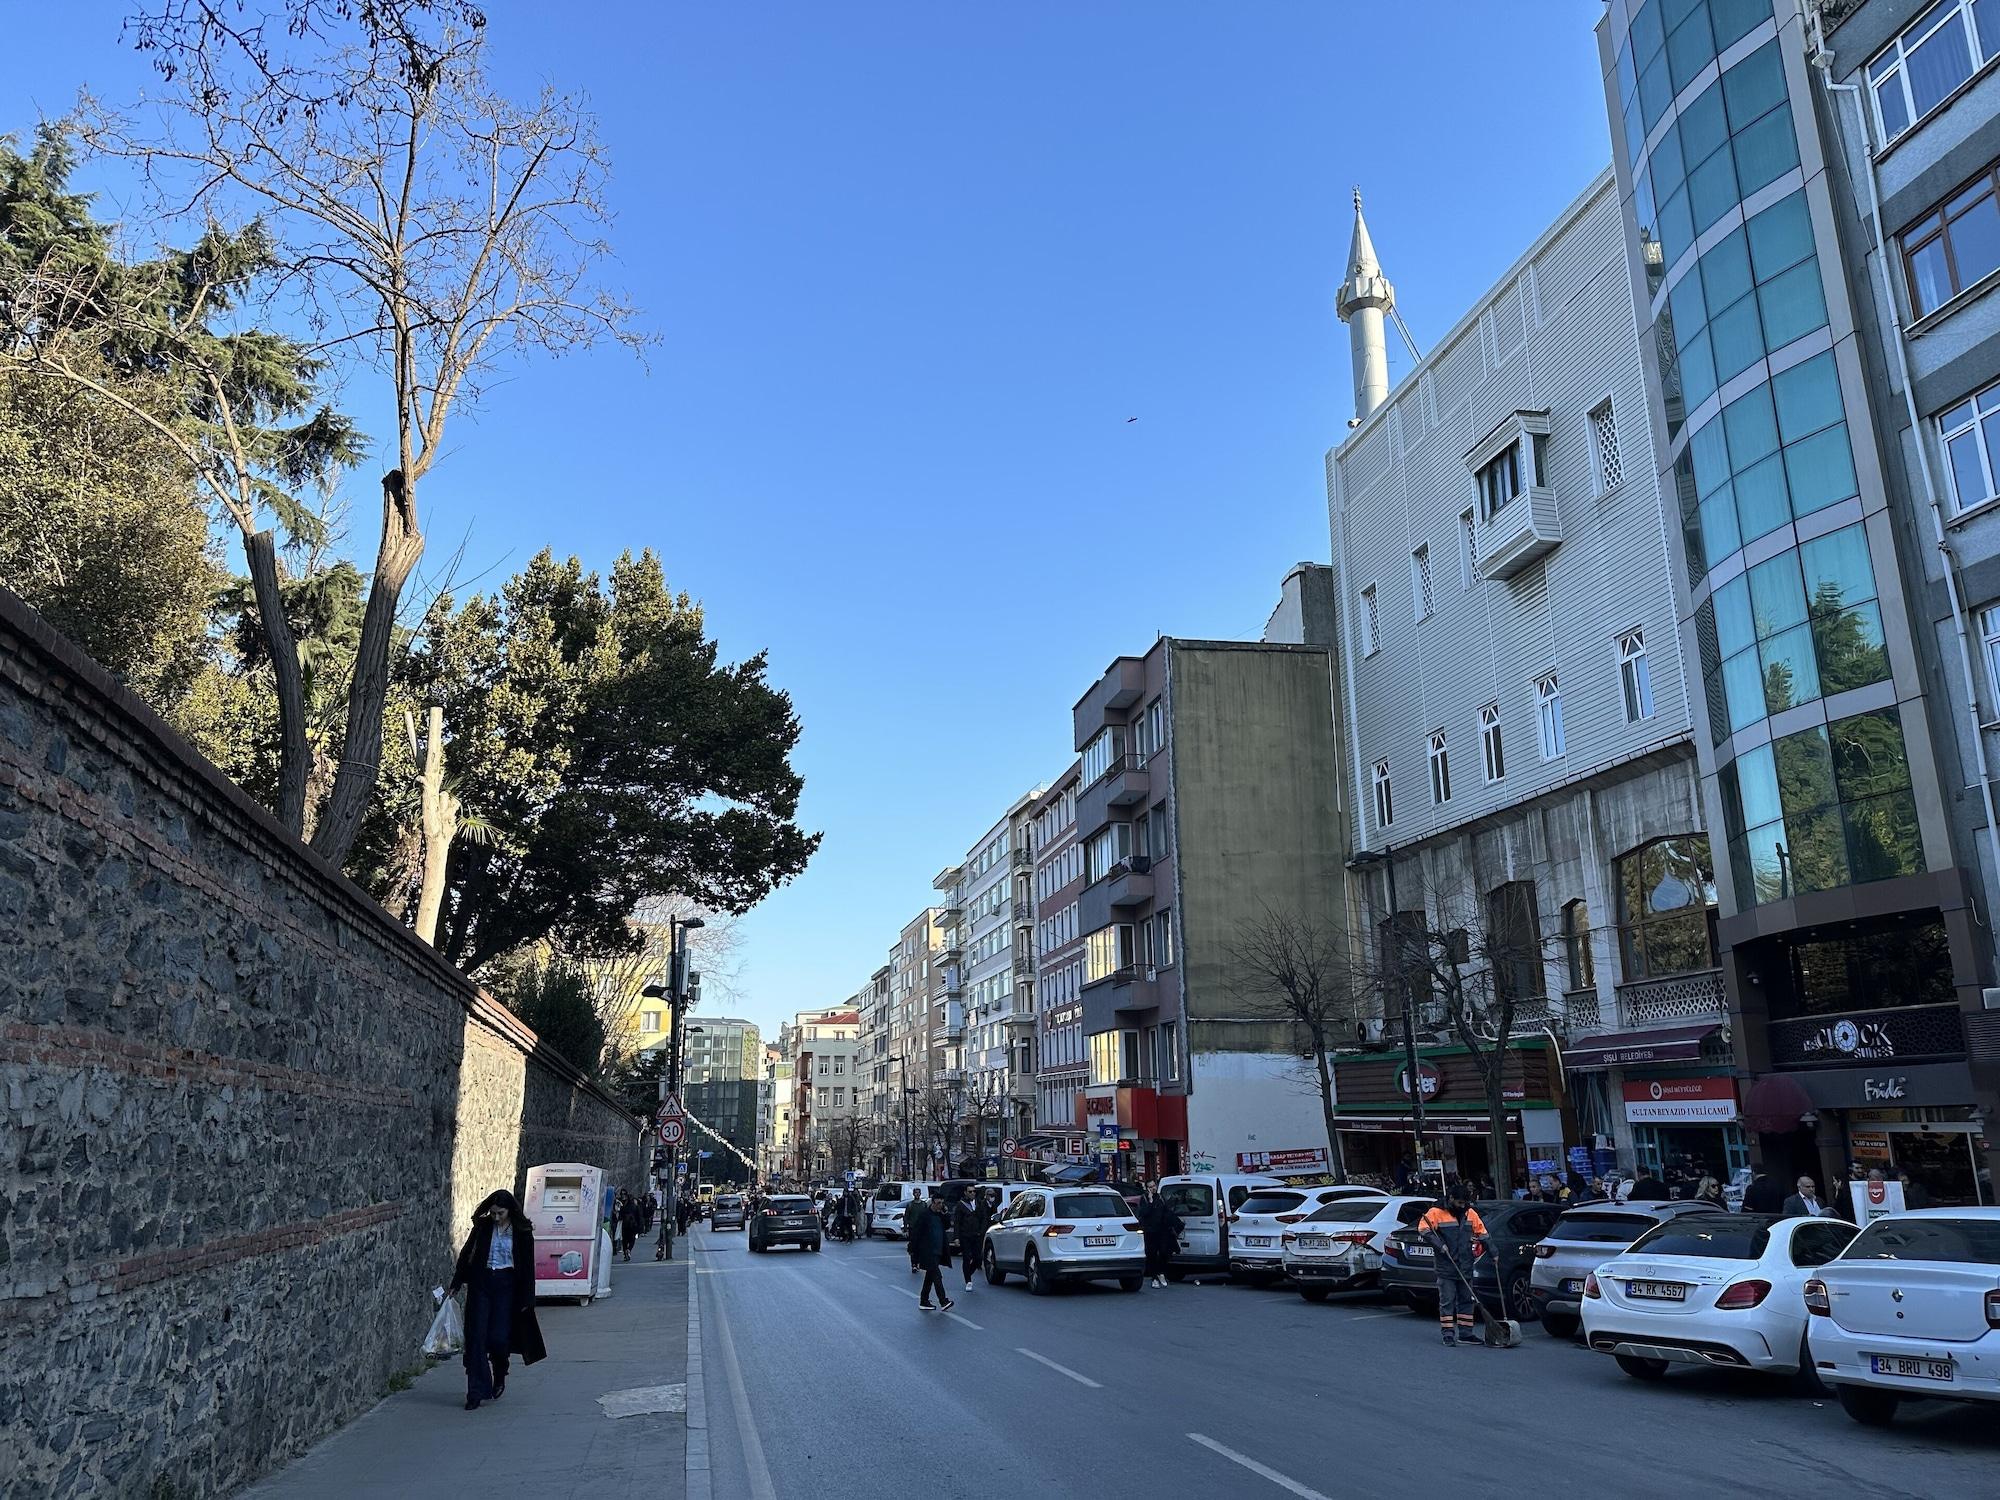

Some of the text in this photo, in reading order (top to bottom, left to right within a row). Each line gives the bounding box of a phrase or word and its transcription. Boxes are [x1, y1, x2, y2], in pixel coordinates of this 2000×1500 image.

[1632, 1108, 1657, 1116] SULTAN
[1707, 1105, 1730, 1115] CAMİİ
[664, 1125, 678, 1138] 30
[1571, 1282, 1581, 1292] 34
[1631, 1281, 1683, 1297] 34 RK 4567
[1878, 1359, 1951, 1378] 34 BRU 498
